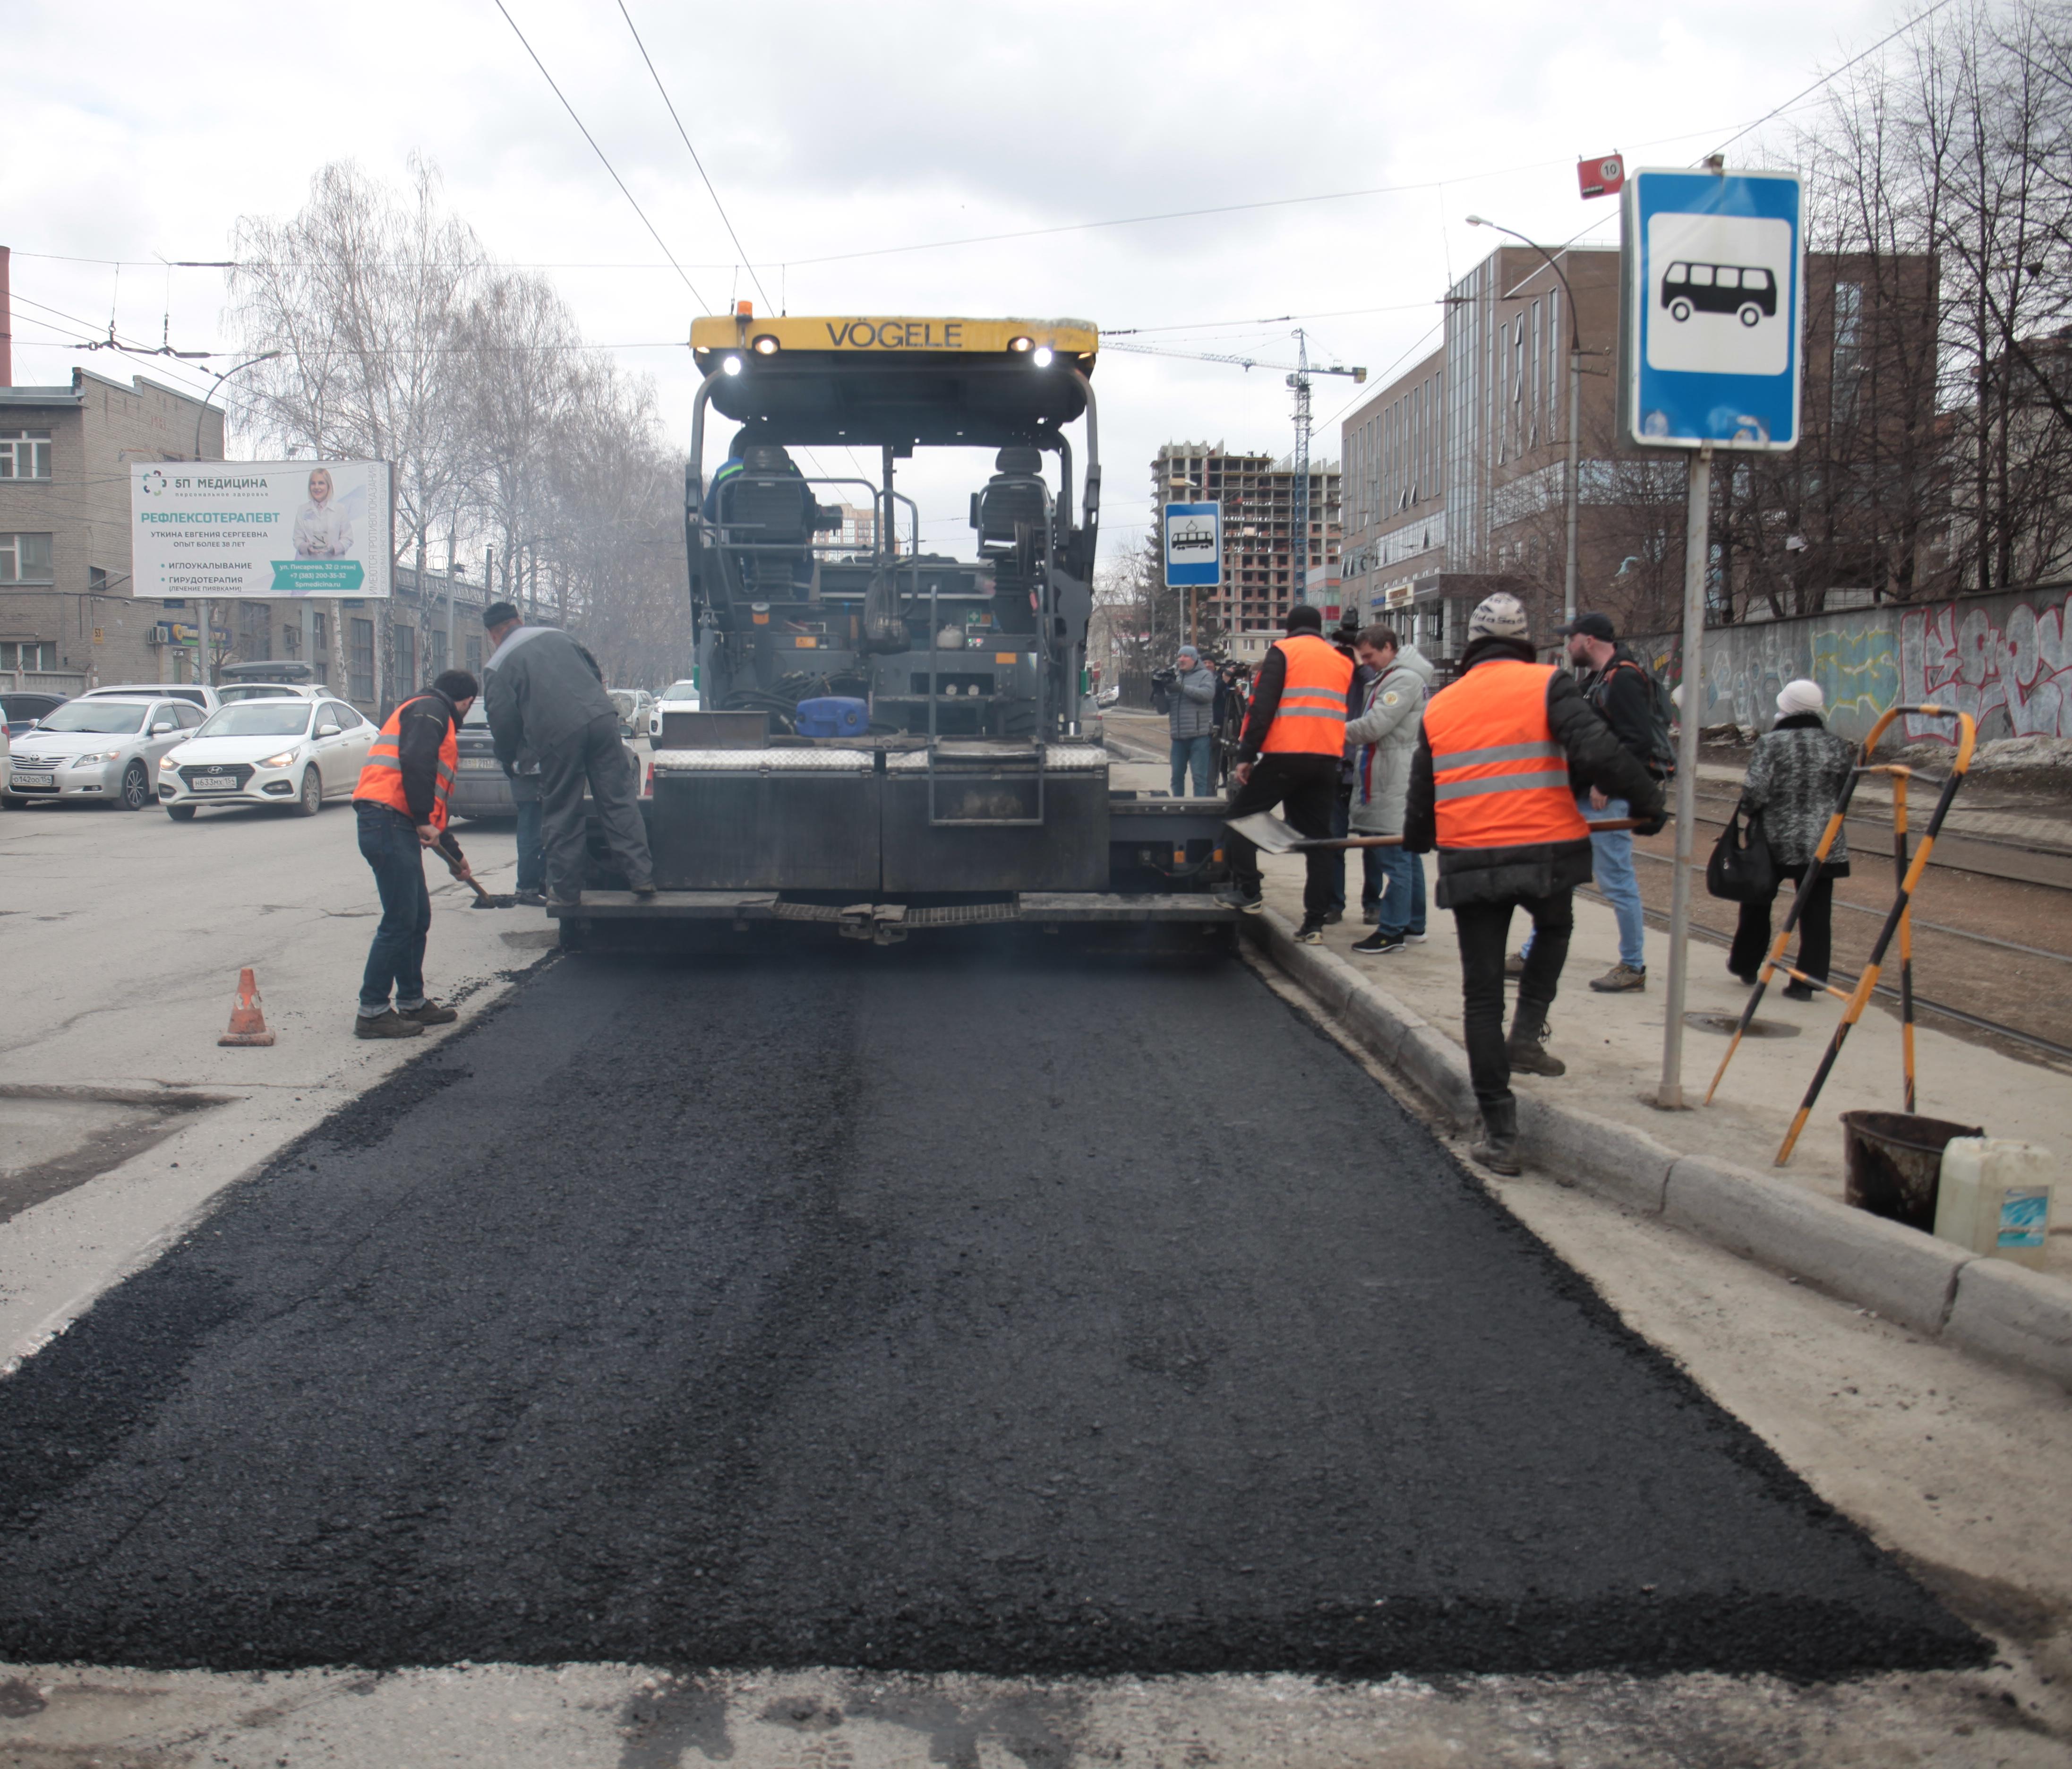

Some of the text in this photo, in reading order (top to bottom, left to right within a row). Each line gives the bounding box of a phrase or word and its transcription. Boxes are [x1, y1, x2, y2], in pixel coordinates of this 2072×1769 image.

[1604, 164, 1616, 176] 10
[825, 318, 962, 348] VÖGELE
[175, 479, 268, 489] 5П МЕДИЦИНА
[141, 512, 280, 523] РЕФЛЕКСОТЕРАПЕВТ
[169, 576, 243, 584] ГИРУДОТЕРАПИЯ
[368, 555, 377, 595] ИМЕЮТСЯ
[95, 628, 101, 637] 53
